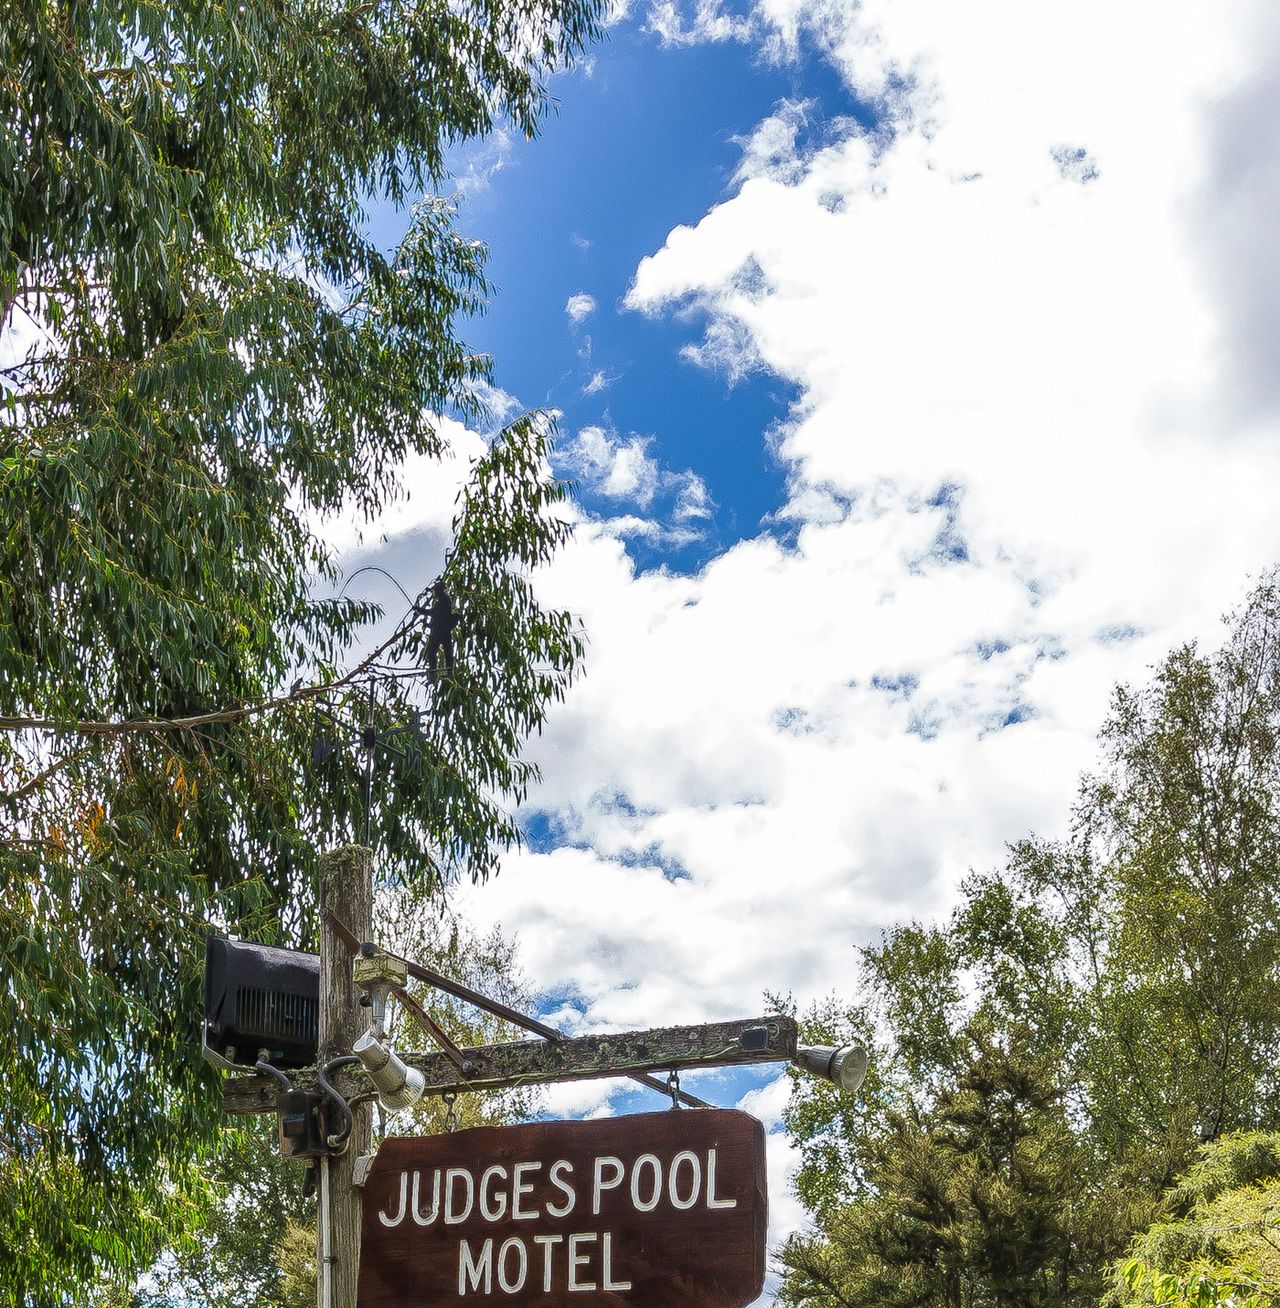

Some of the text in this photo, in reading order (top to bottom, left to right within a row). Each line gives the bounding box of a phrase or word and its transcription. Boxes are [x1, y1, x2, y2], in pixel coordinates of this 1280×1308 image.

[378, 1148, 737, 1228] JUDGES POOL
[458, 1231, 632, 1296] MOTEL
